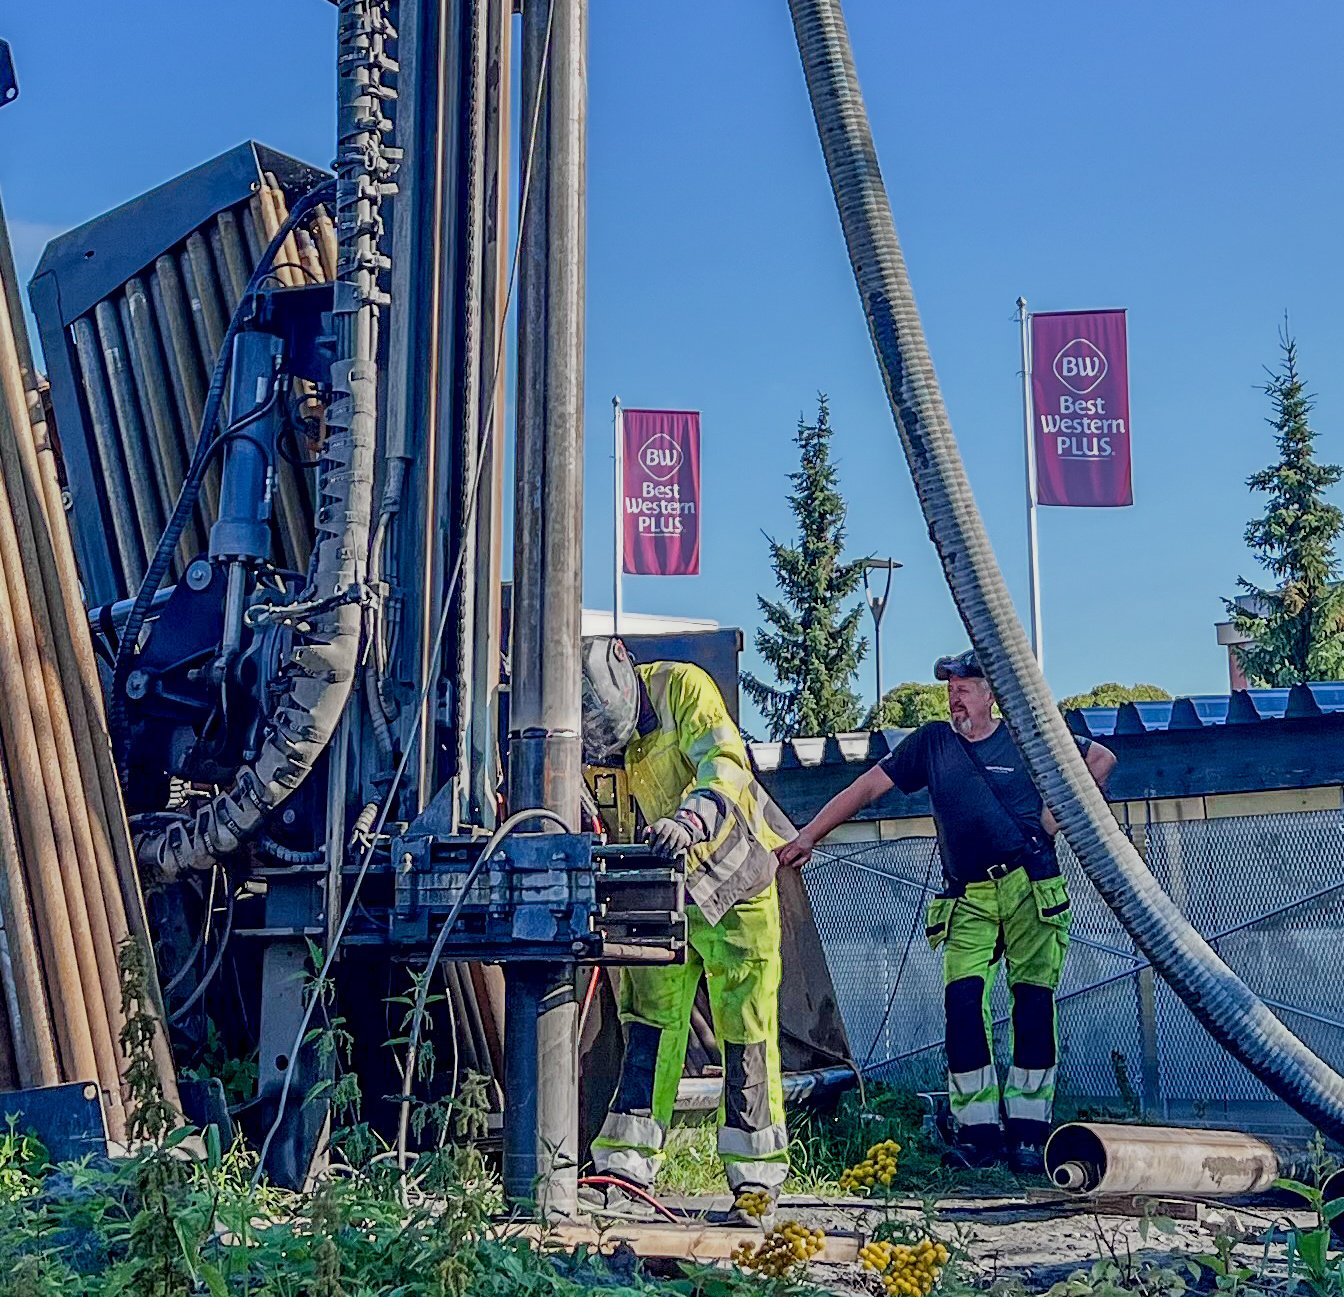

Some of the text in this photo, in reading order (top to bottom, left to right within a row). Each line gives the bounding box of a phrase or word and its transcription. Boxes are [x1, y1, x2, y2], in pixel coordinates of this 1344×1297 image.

[1062, 356, 1099, 377] BW
[1059, 395, 1106, 415] Best
[1040, 414, 1126, 434] Western
[1056, 436, 1113, 456] PLUS
[646, 448, 677, 466] BW
[642, 481, 680, 499] Best
[625, 496, 696, 514] Western
[638, 516, 683, 533] PLUS
